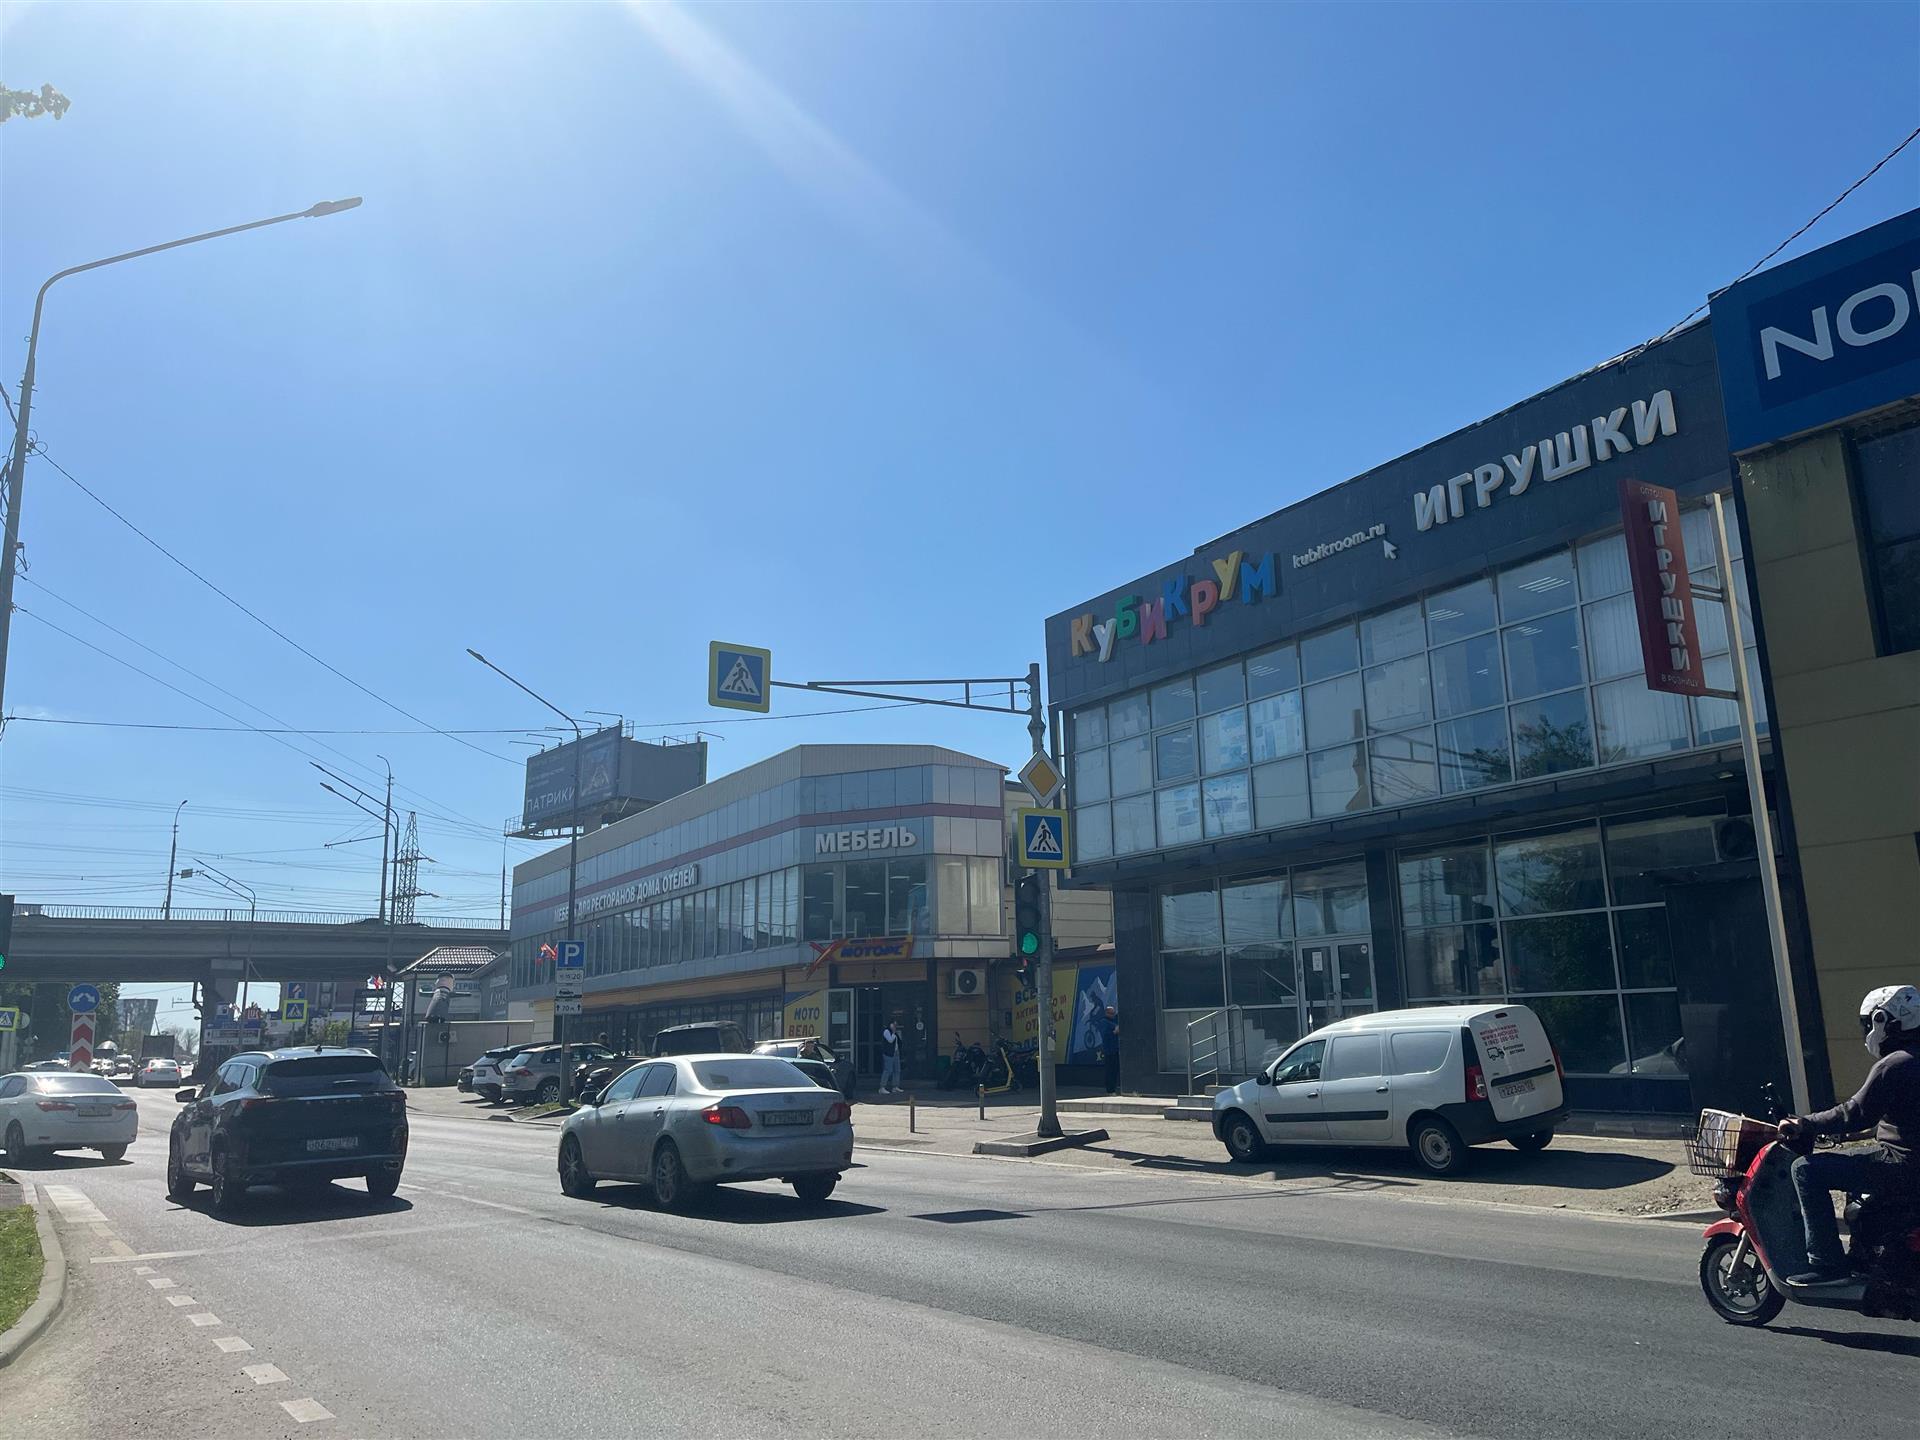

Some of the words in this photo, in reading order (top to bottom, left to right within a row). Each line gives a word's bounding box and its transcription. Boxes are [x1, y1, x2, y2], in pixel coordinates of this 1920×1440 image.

[1414, 389, 1677, 532] ИГРУШКИ
[1293, 522, 1386, 569] kubikroom.ru
[1648, 499, 1691, 672] ИГРУШКИ
[815, 826, 917, 854] МЕБЕЛЬ
[590, 886, 636, 912] РЕСТОРАНОВ
[637, 879, 661, 904] ДОМА
[662, 864, 696, 892] ОТЕЛЕЙ
[788, 1024, 815, 1037] ВЕЛО
[794, 1007, 820, 1021] МОТО
